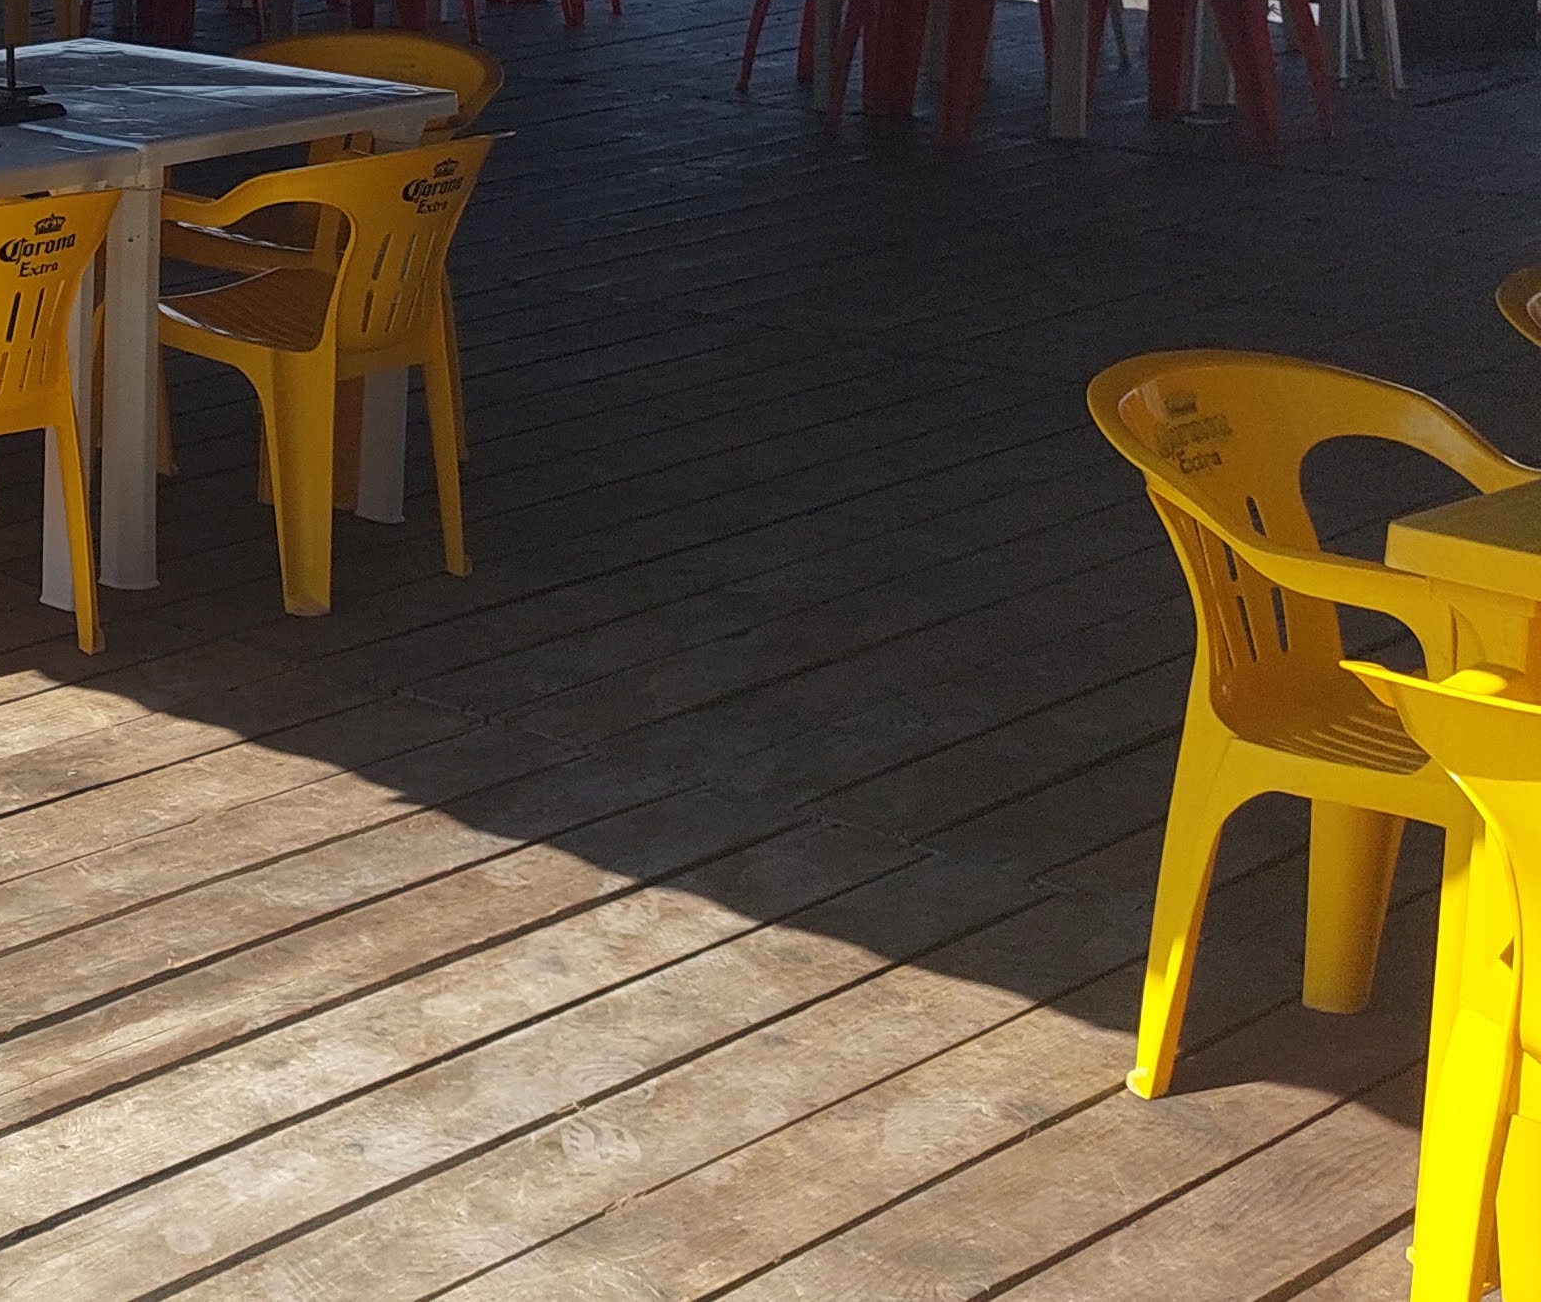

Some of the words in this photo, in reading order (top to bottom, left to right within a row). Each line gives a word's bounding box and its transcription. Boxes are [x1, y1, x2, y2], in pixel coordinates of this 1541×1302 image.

[402, 177, 464, 203] Corona
[417, 199, 448, 215] Extra
[18, 261, 59, 278] Extra
